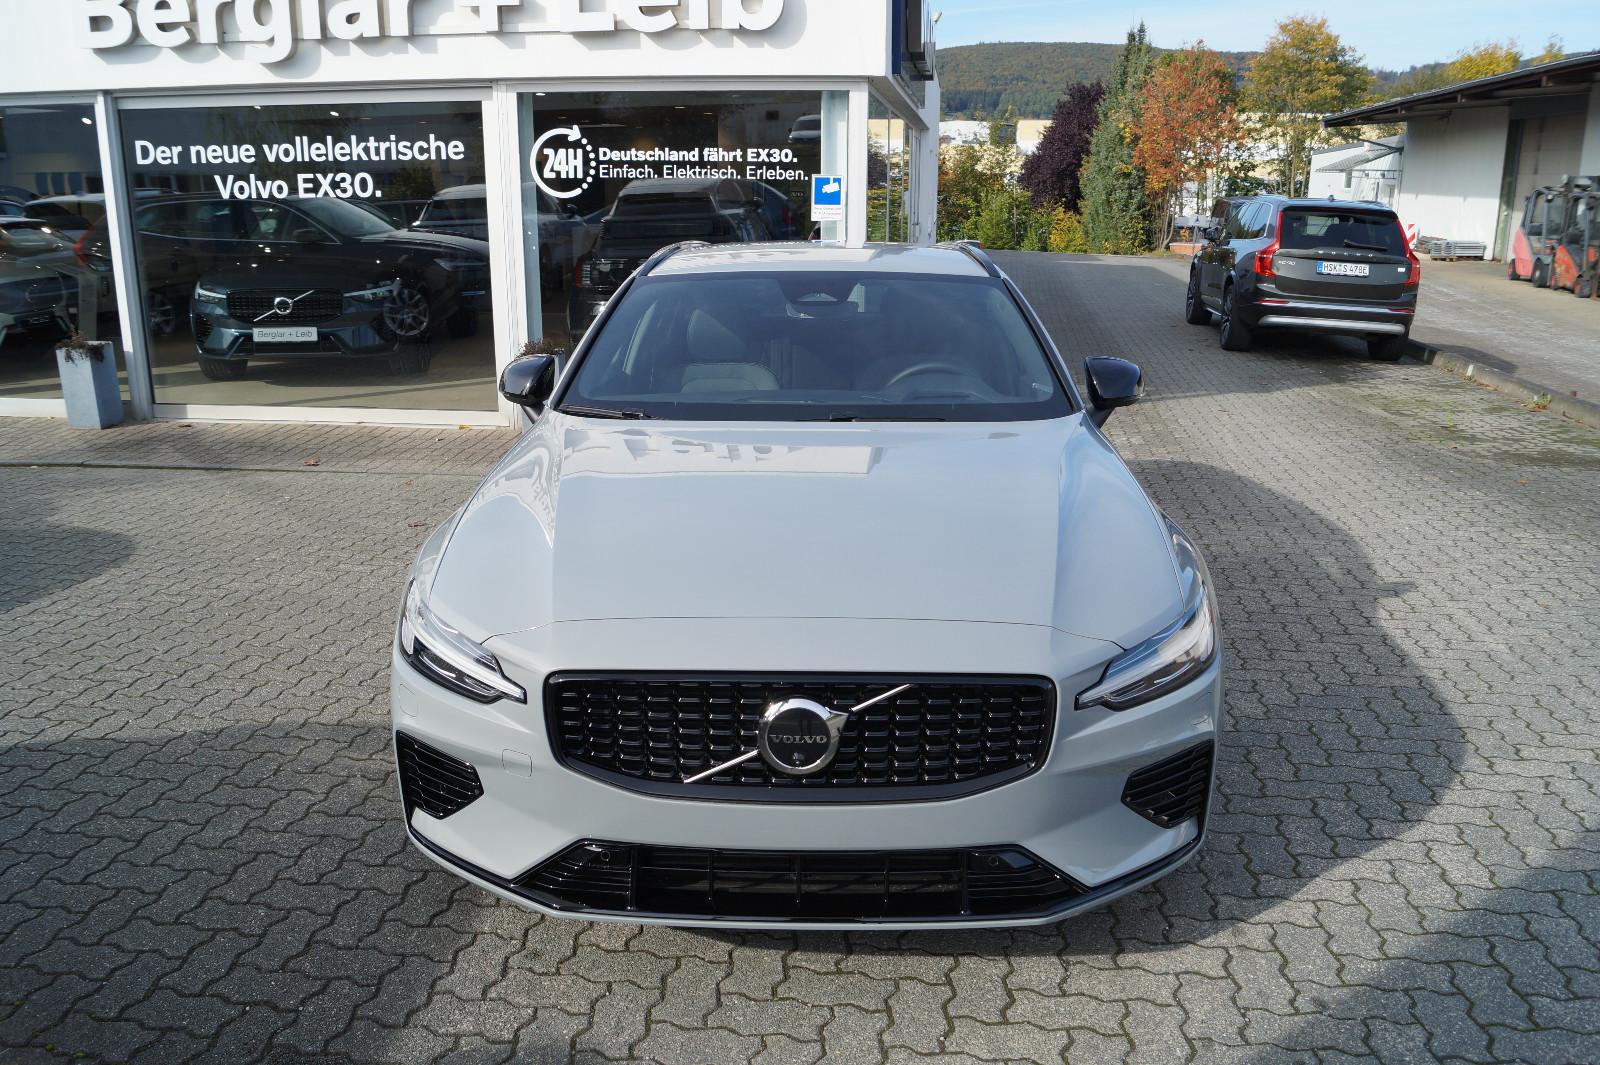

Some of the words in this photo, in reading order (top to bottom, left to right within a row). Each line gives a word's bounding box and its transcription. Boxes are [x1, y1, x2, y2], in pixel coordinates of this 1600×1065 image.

[134, 140, 182, 165] Der
[190, 142, 256, 164] neue
[262, 134, 465, 163] vollelektrische
[598, 147, 699, 162] Deutschland
[703, 148, 743, 162] fährt
[746, 148, 798, 163] EX30.
[543, 148, 583, 179] 24H
[599, 165, 658, 179] Einfach.
[663, 164, 741, 180] Elektrisch.
[746, 166, 809, 181] Erleben.
[214, 173, 289, 199] Volvo
[297, 172, 382, 198] EX30.
[257, 331, 285, 339] Berglar
[296, 330, 313, 338] Leib
[769, 735, 827, 743] VOLVO
